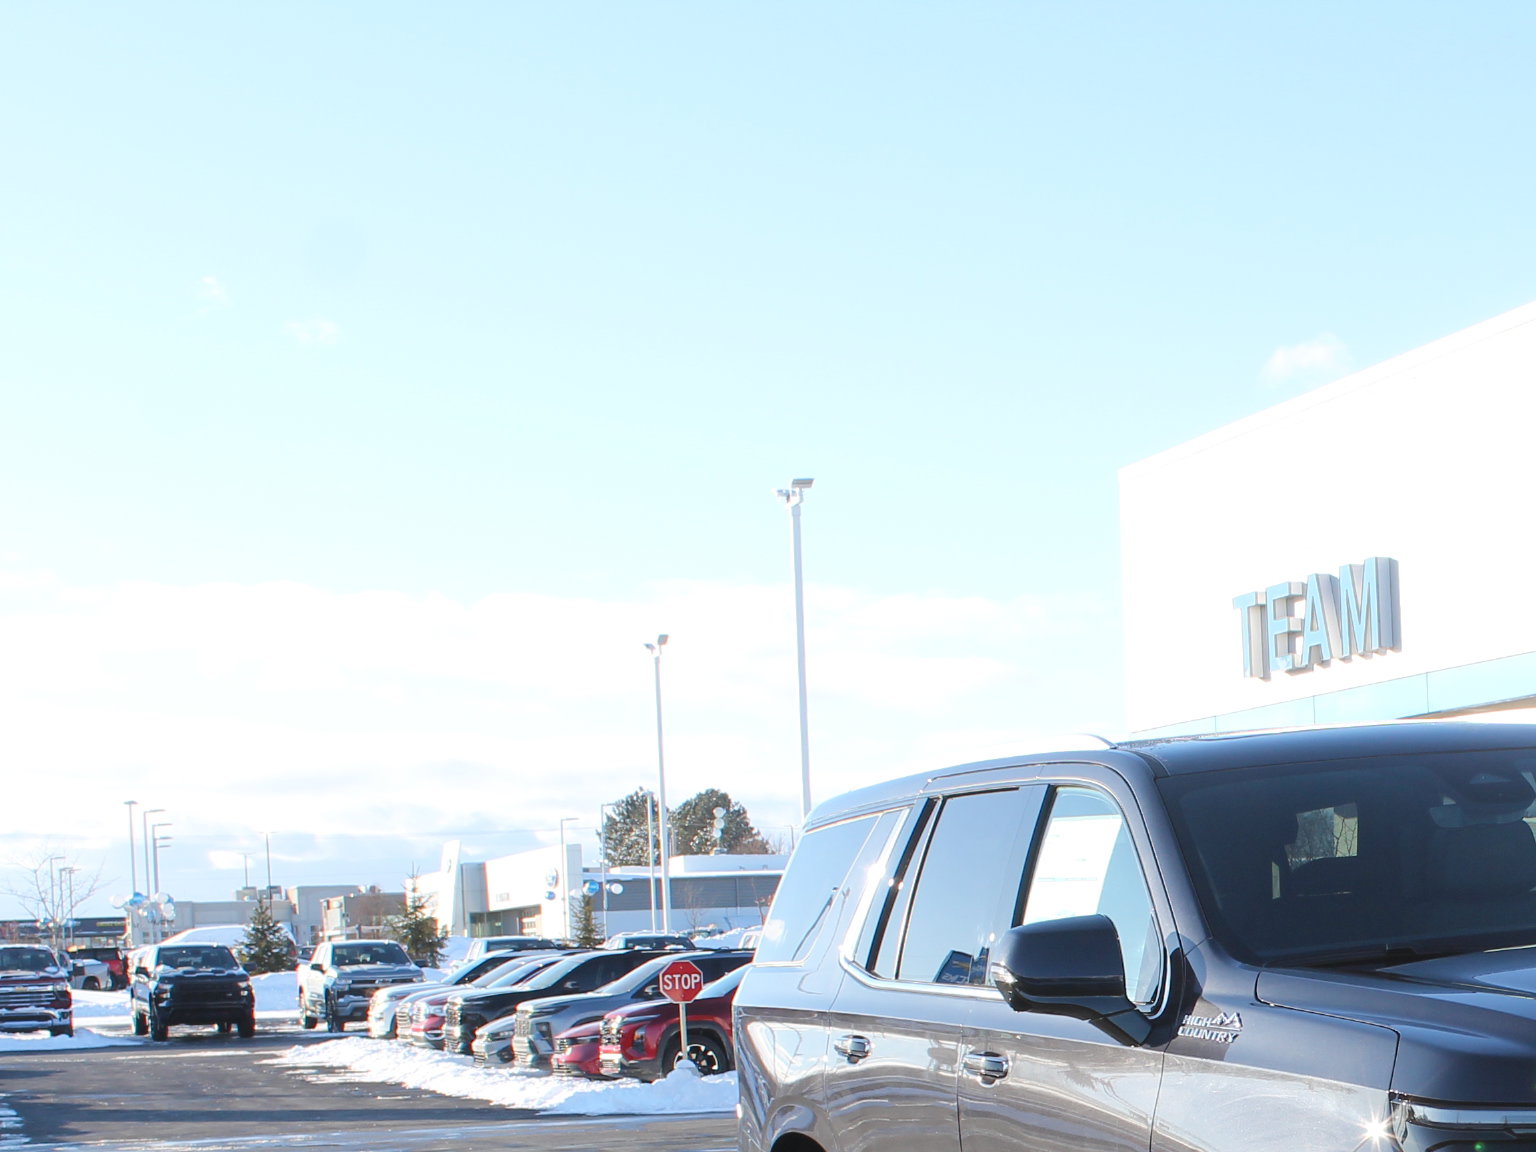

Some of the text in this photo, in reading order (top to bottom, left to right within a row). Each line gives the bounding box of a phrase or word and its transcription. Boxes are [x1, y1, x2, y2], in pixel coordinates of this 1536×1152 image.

[1232, 556, 1392, 678] TEAM
[663, 973, 700, 990] STOP
[1182, 1014, 1212, 1027] HIGH
[1178, 1026, 1238, 1043] COUNTRY
